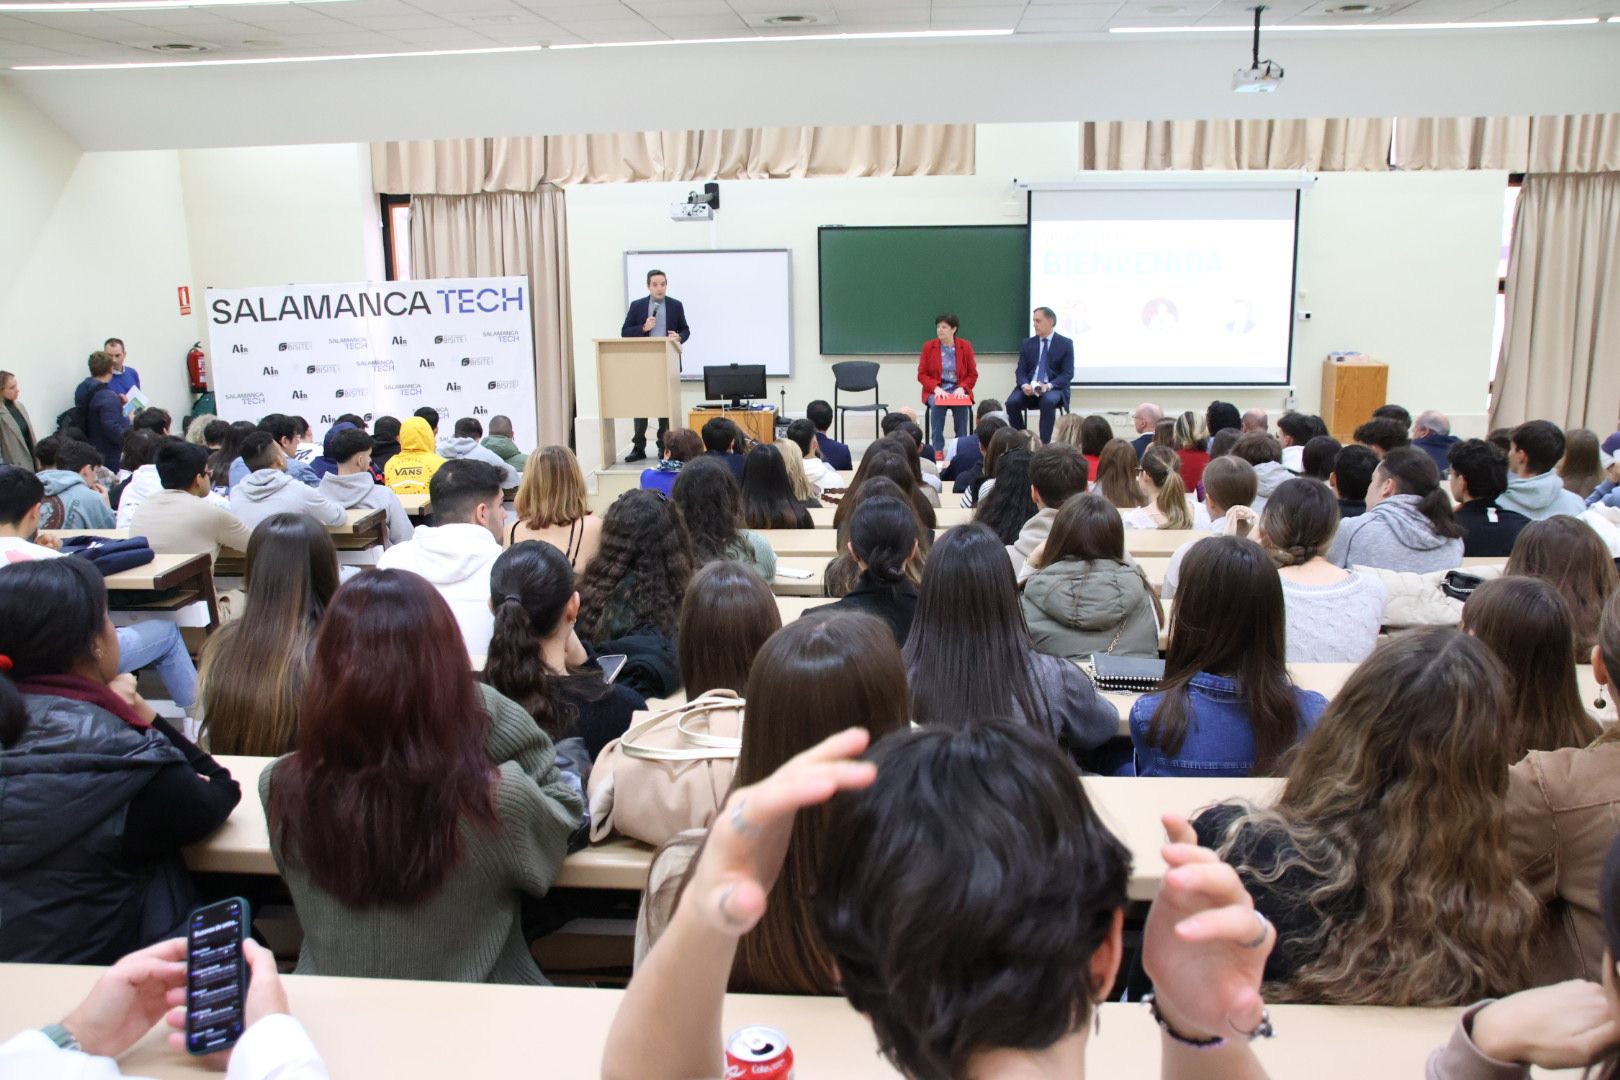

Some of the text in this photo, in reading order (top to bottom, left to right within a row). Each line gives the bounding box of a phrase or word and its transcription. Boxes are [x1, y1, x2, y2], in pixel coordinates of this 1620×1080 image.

[212, 286, 523, 325] SALAMANCA TECH
[497, 335, 520, 343] TECH
[345, 342, 368, 350] TECH
[373, 364, 395, 372] TECH
[400, 388, 422, 396] TECH
[242, 397, 265, 405] TECH
[394, 466, 423, 476] VANS
